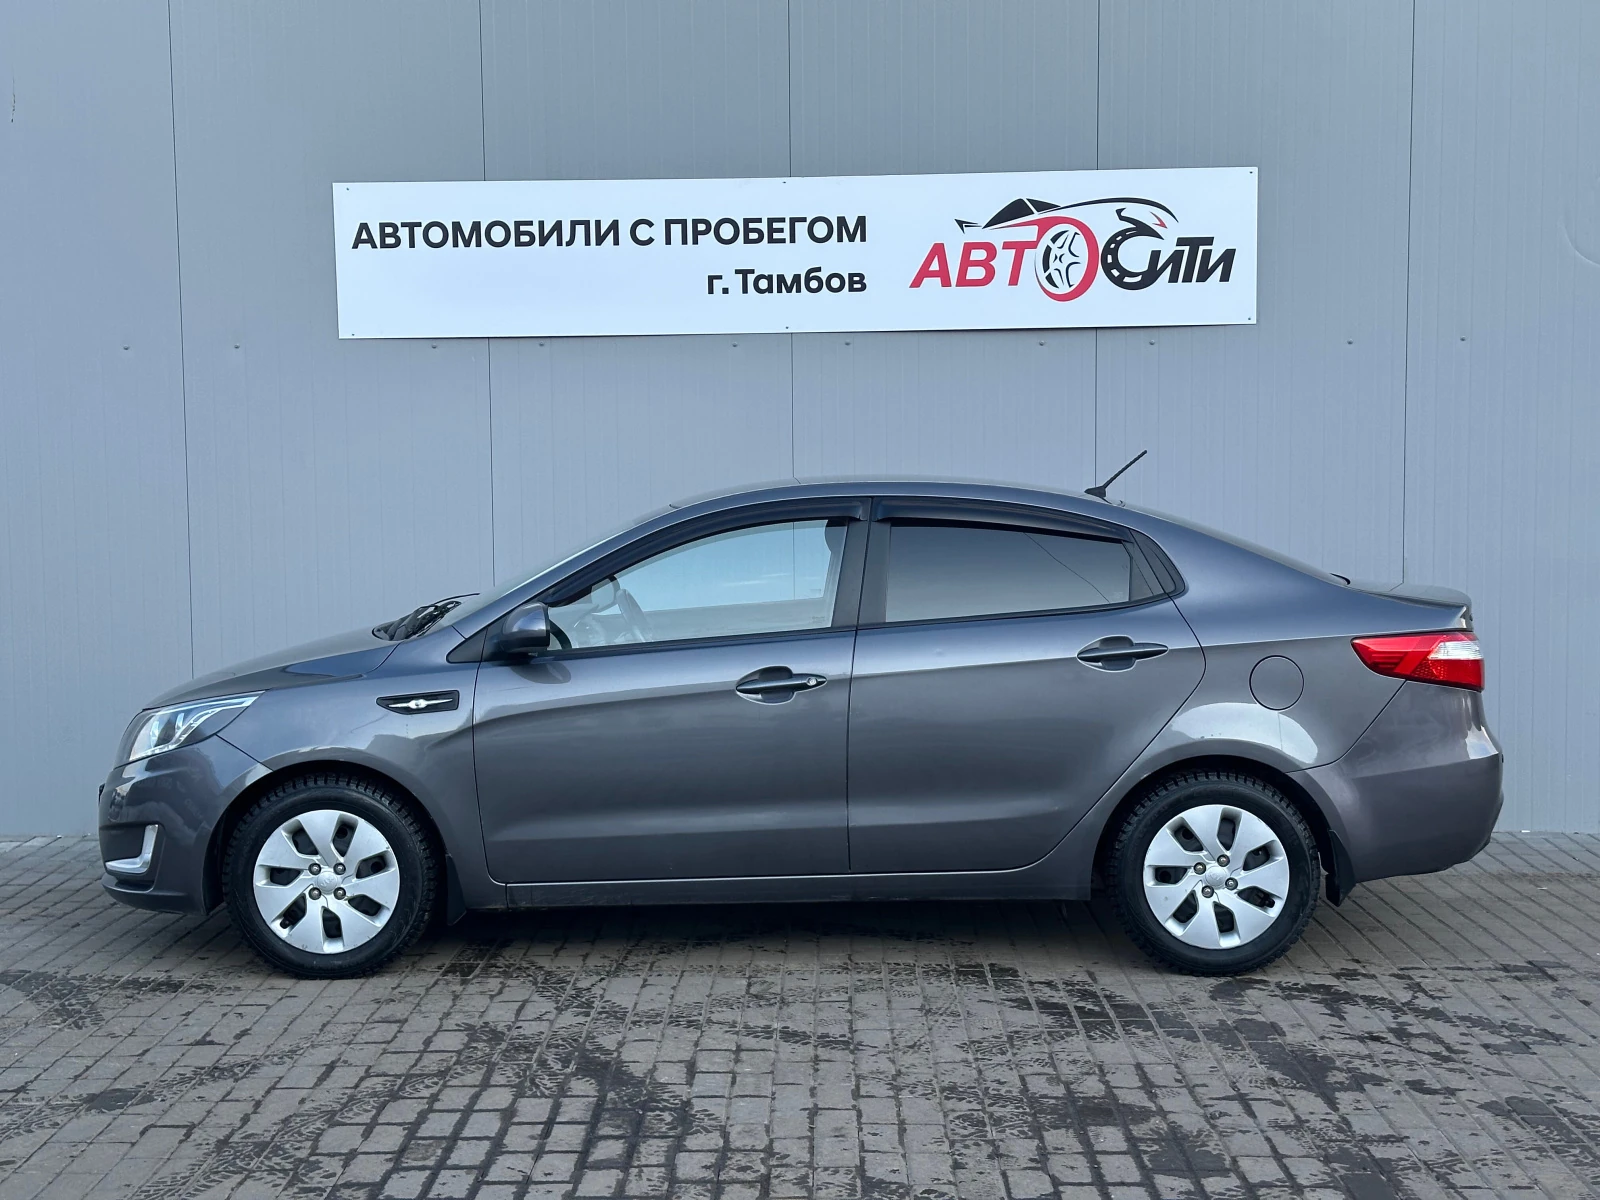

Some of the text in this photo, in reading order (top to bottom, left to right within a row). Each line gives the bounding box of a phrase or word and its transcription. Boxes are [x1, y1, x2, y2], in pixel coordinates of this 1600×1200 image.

[351, 215, 867, 250] АВТОМОБИЛИ С ПРОБЕГОМ
